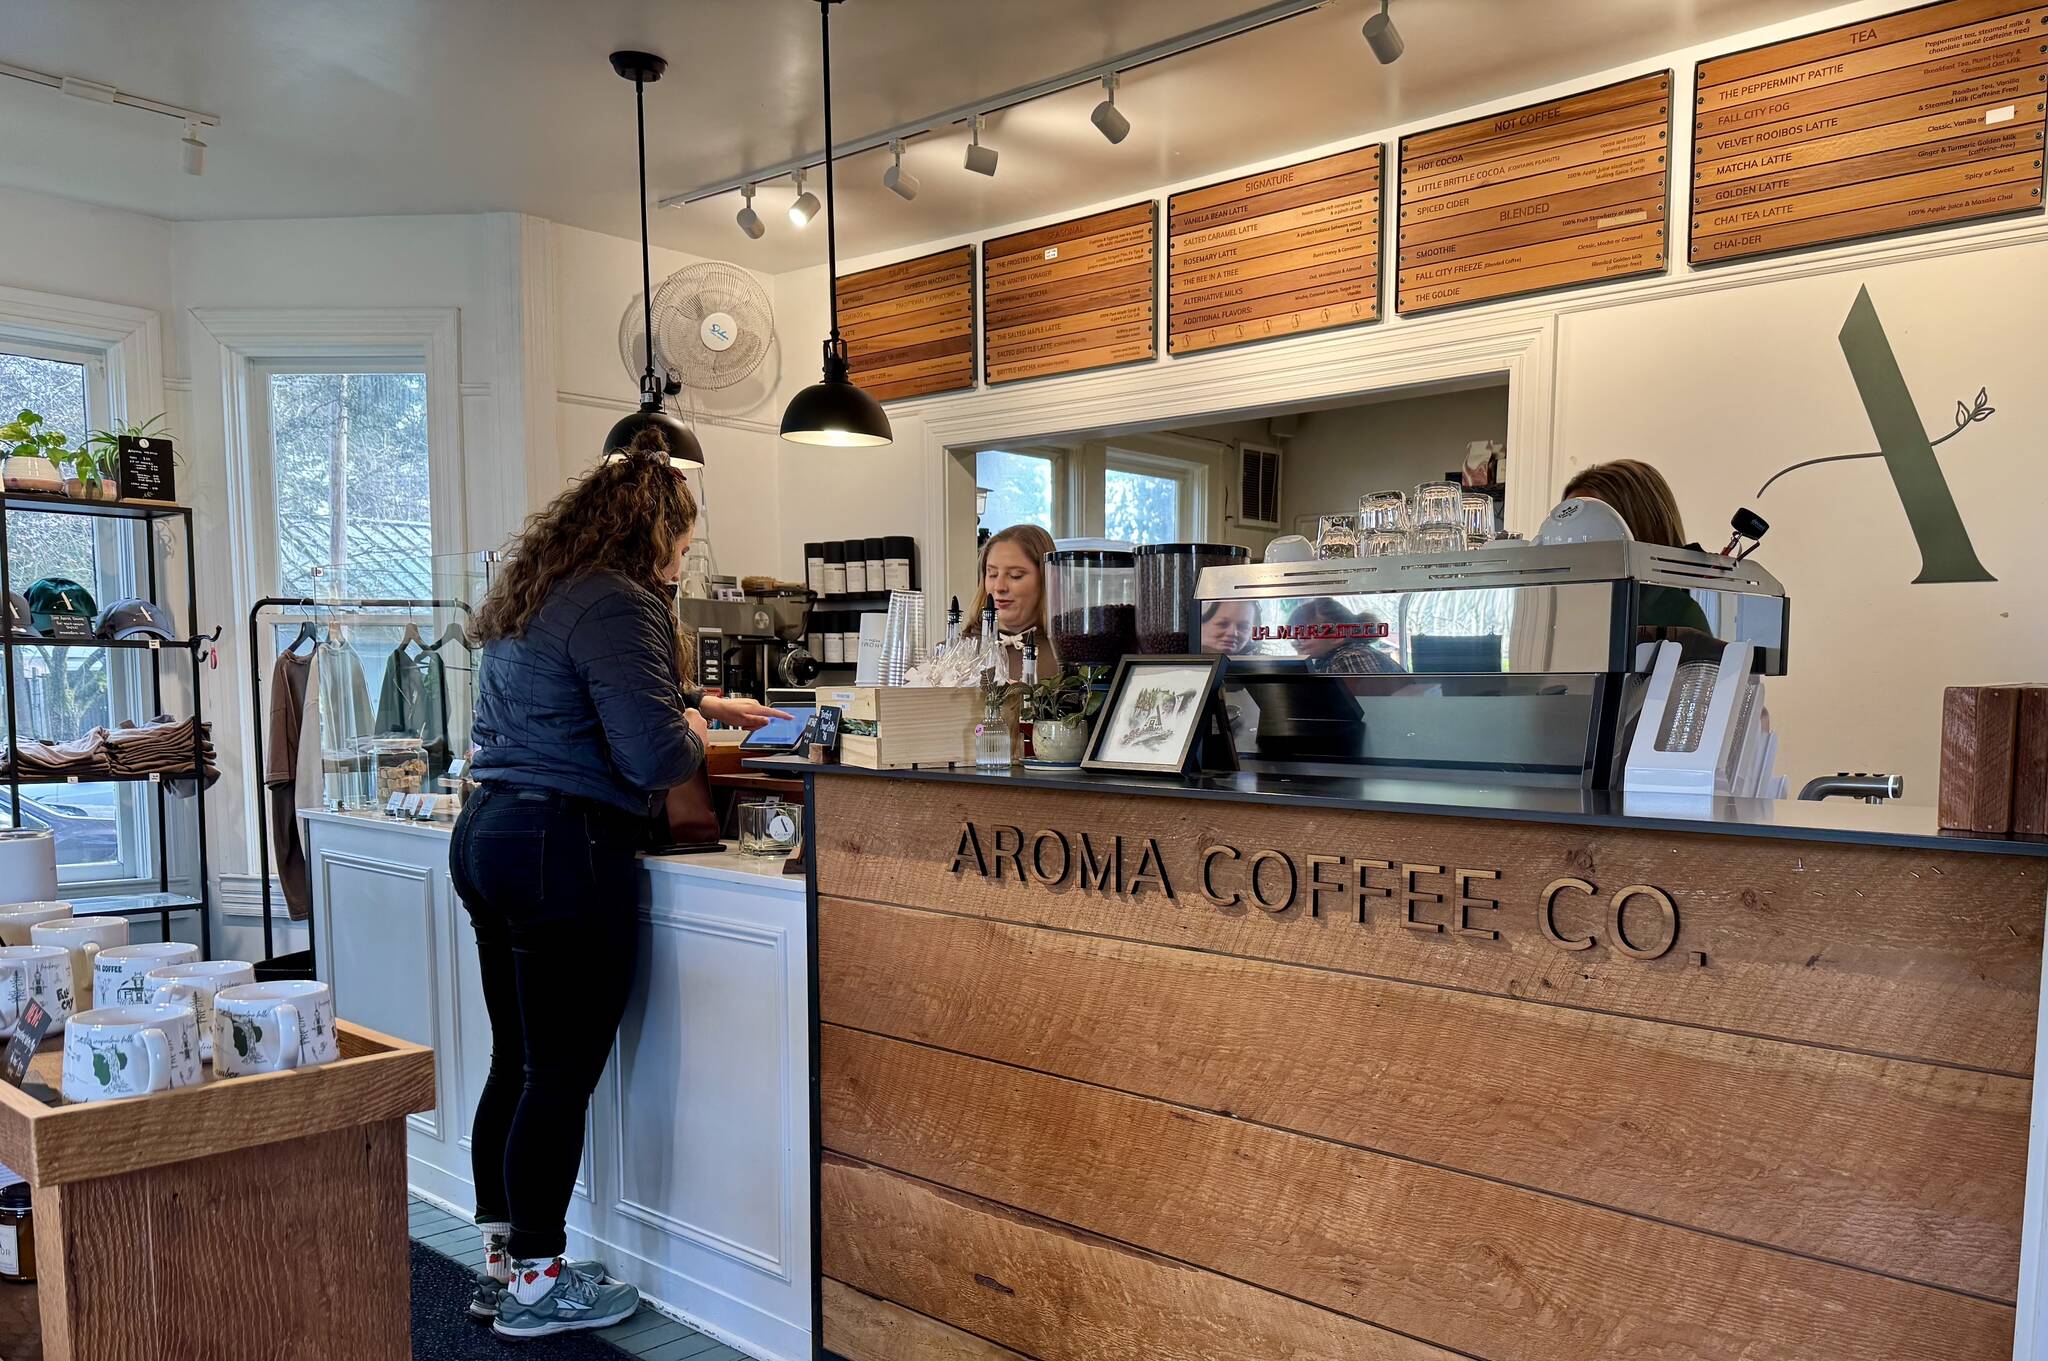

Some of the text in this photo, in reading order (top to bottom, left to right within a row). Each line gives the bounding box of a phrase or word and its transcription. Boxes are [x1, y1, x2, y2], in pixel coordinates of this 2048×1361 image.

[1850, 27, 1877, 44] TEA
[1925, 33, 1962, 49] Peppermint
[1964, 30, 1976, 39] tea,
[1978, 23, 2007, 35] steamed
[2008, 19, 2022, 28] milk
[1928, 25, 2029, 55] chocolate sauce (caffeine free)
[2006, 56, 2020, 64] Milk
[1719, 63, 1843, 100] THE PEPPERMINT PATTIE
[1996, 76, 2019, 87] Vanilla
[1924, 98, 1953, 110] Steamed
[1954, 95, 1968, 103] Milk
[1970, 88, 2000, 101] (Caffeine
[2001, 84, 2018, 94] Free)
[1494, 107, 1560, 132] NOT COFFEE
[1718, 101, 1789, 125] FALL CITY FOG
[1717, 117, 1837, 150] VELVET ROOIBOS LATTE
[1927, 122, 1952, 133] Classic,
[1954, 117, 1976, 127] Vanilla
[1917, 148, 1939, 158] Ginger
[1948, 140, 1975, 151] Turmeric
[1977, 135, 2000, 146] Golden
[2002, 132, 2016, 141] Milk
[1418, 154, 1463, 171] HOT COCOA
[1716, 152, 1792, 175] MATCHA LATTE
[1245, 172, 1293, 192] SIGNATURE
[1417, 180, 1441, 193] LITTLE
[1443, 173, 1474, 187] BRITTLE
[1476, 166, 1504, 179] COCOA
[1964, 171, 1982, 180] Spicy
[1993, 165, 2014, 174] Sweet
[1715, 178, 1789, 200] GOLDEN LATTE
[1183, 204, 1247, 226] VANILLA BEAN LATTE
[1417, 197, 1469, 215] SPICED CIDER
[1499, 201, 1549, 221] BLENDED
[1714, 204, 1792, 226] CHAI TEA LATTE
[1908, 208, 1925, 216] 100%
[1927, 205, 1946, 213] Apple
[1972, 197, 1995, 206] Masala
[1183, 223, 1257, 246] SALTED CARAMEL LATTE
[1713, 234, 1761, 250] CHAI-DER
[1183, 248, 1237, 265] ROSEMARY LATTE
[1416, 244, 1456, 259] SMOOTHIE
[996, 260, 1006, 269] THE
[1416, 270, 1433, 280] FALL
[1435, 267, 1452, 277] CITY
[1454, 261, 1482, 273] FREEZE
[1184, 277, 1194, 285] THE
[1196, 274, 1207, 283] BEE
[1223, 268, 1238, 277] TREE
[1183, 287, 1242, 305] ALTERNATIVE MILKS
[1415, 287, 1459, 302] THE GOLDIE
[1183, 306, 1252, 324] ADDITIONAL FLAVORS:
[1045, 323, 1061, 331] LATTE
[951, 821, 1707, 967] AROMA COFFEE CO.
[101, 964, 123, 974] COFFEE
